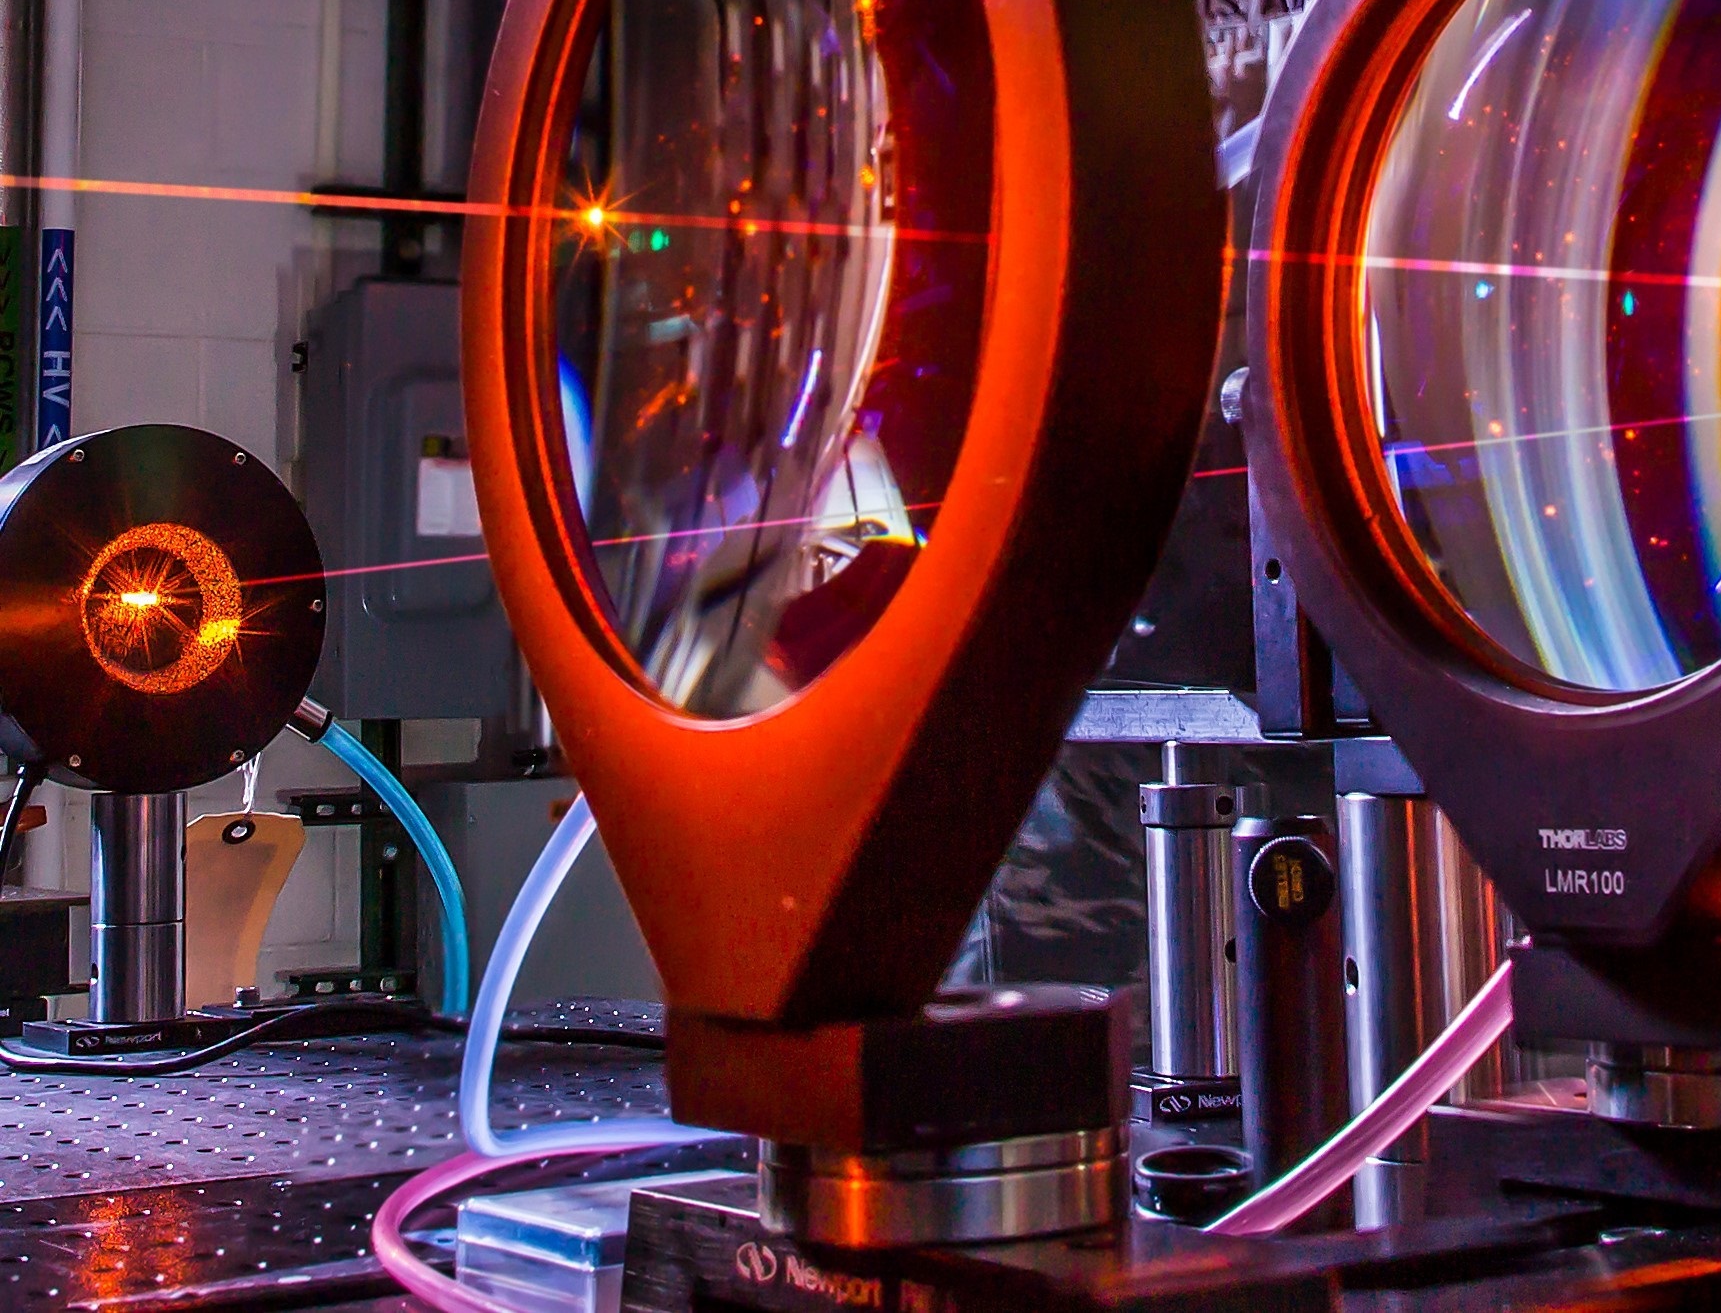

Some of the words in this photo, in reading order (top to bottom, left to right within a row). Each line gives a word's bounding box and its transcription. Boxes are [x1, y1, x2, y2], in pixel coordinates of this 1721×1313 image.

[43, 350, 71, 408] HV
[1538, 829, 1628, 851] THORLABS
[1545, 868, 1625, 896] LMR100
[1198, 1093, 1242, 1109] Newp
[786, 1254, 883, 1308] Newport
